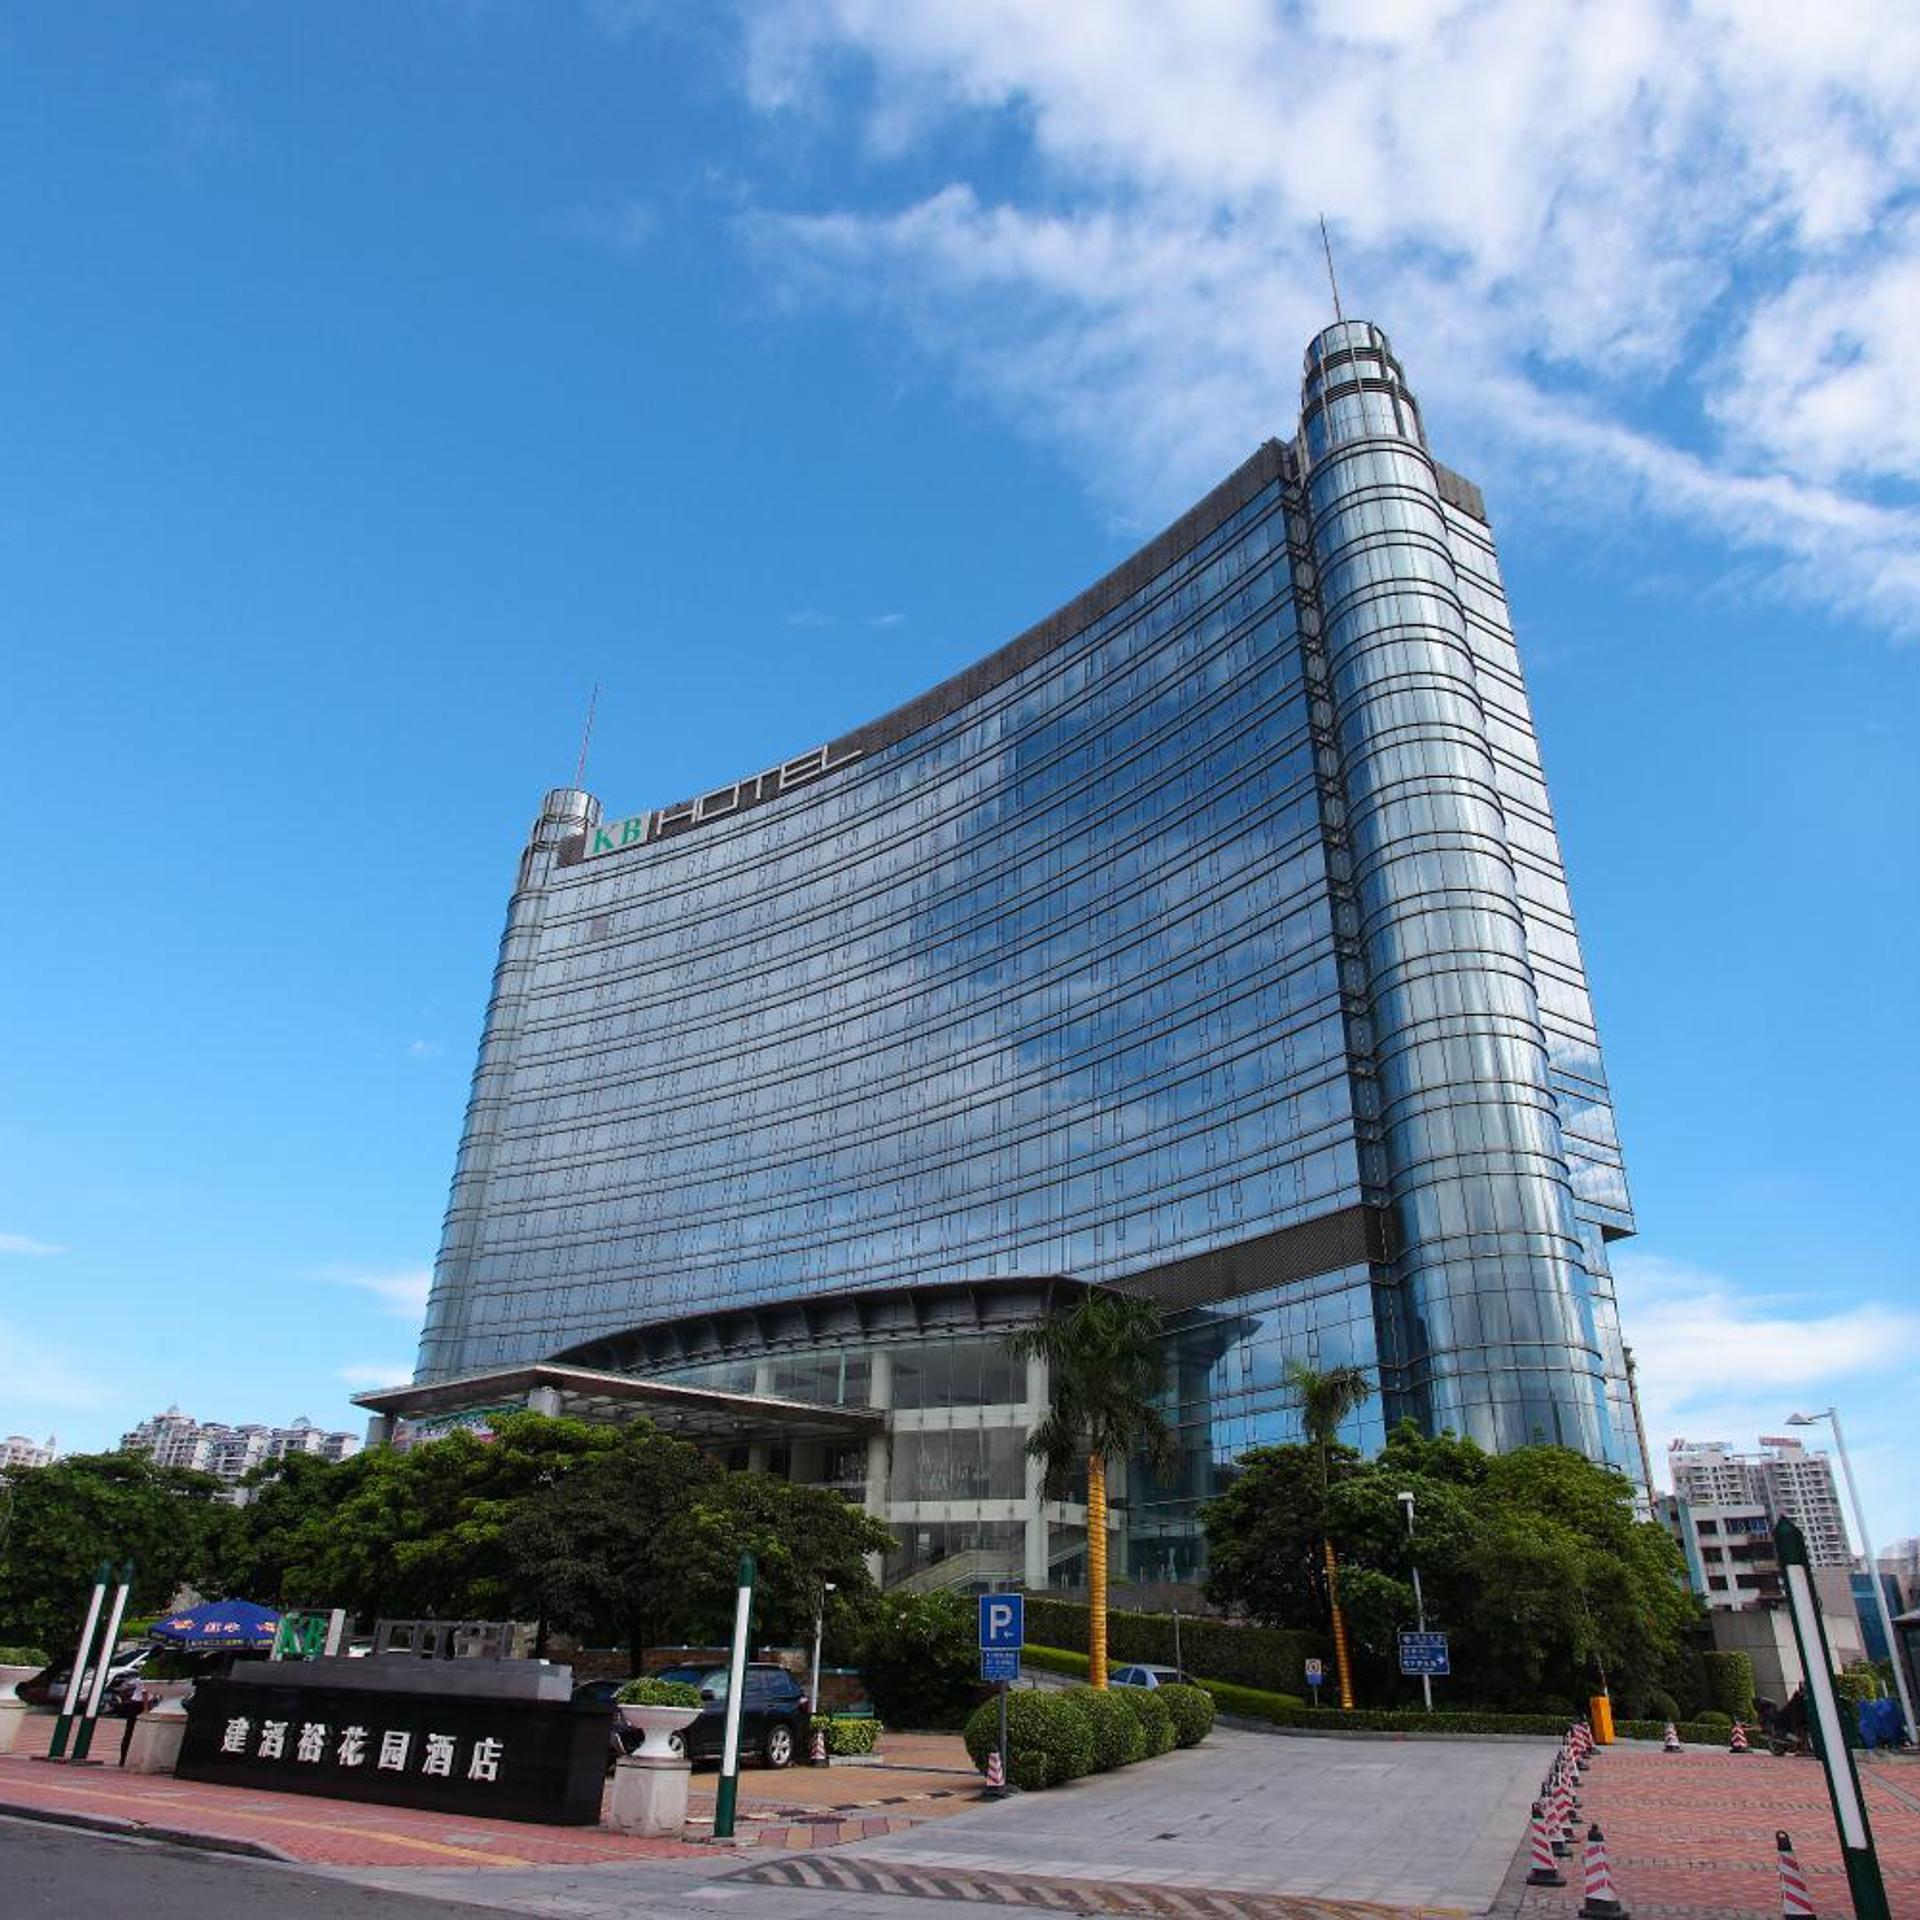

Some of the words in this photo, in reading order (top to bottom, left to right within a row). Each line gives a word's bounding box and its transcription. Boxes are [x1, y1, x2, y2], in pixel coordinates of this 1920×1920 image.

[591, 817, 643, 856] KB
[656, 744, 864, 836] HOTEL
[990, 1605, 1013, 1640] P
